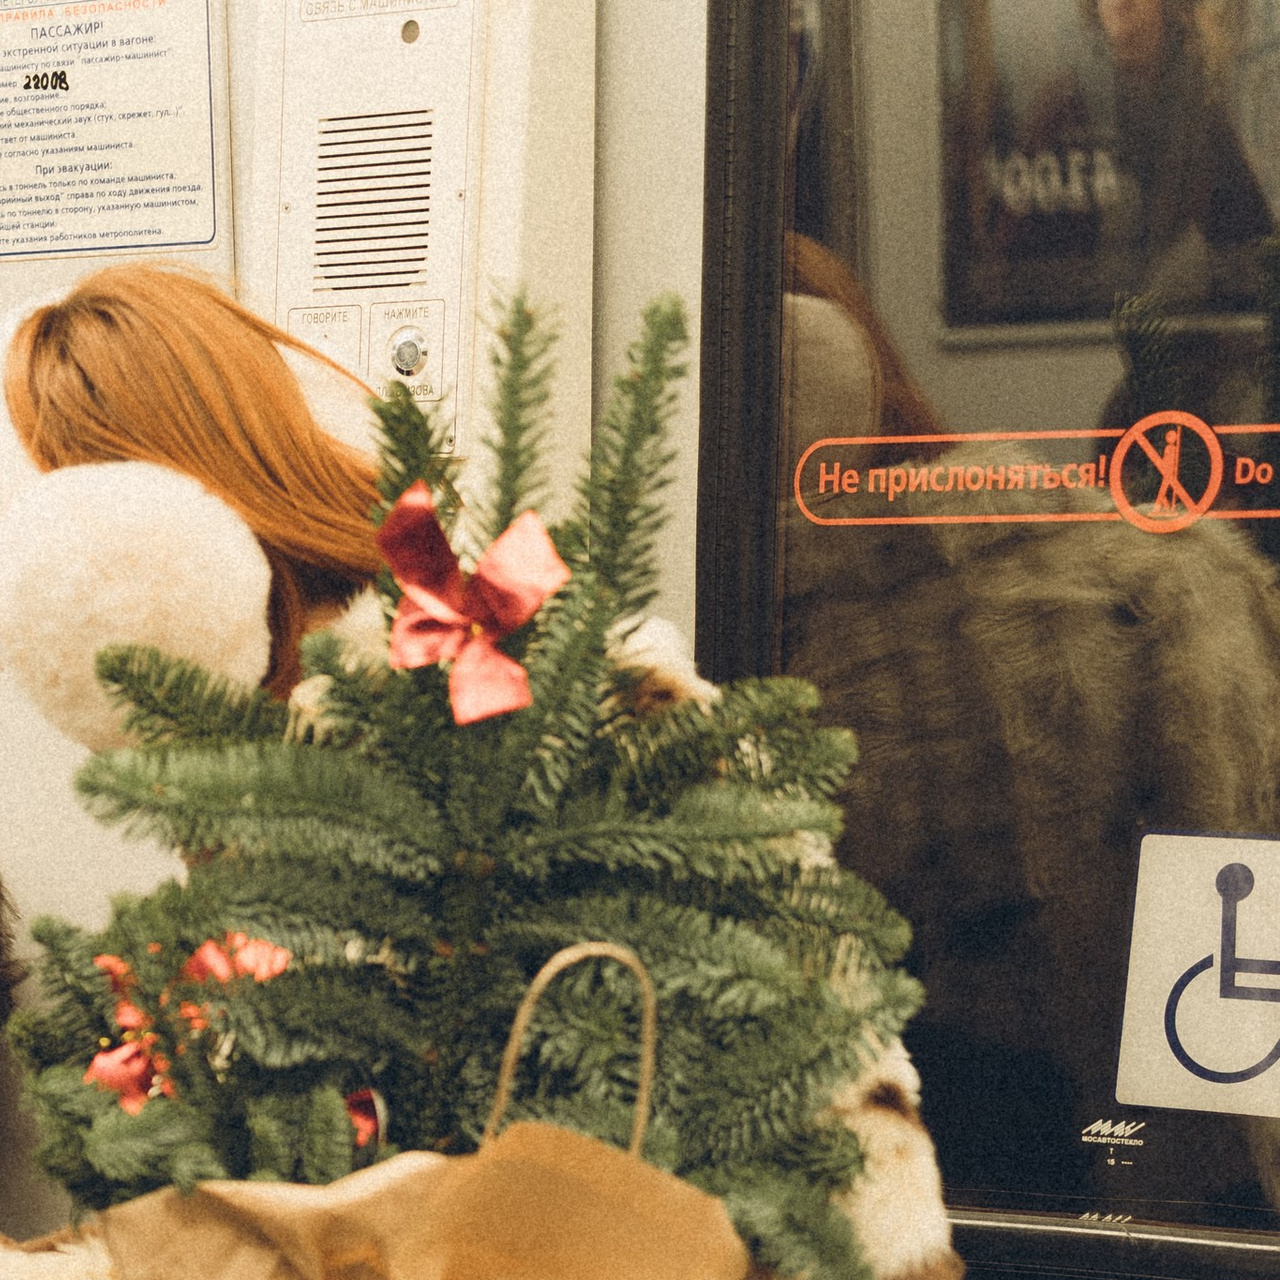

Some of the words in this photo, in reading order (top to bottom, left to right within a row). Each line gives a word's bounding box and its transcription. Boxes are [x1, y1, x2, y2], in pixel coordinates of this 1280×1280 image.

[306, 0, 345, 15] СВЯЗЬ
[30, 22, 104, 39] ПАССАЖИР!
[3, 43, 58, 59] экстренной
[62, 40, 108, 54] ситуации
[120, 35, 156, 46] вагоне:
[7, 105, 68, 116] общественного
[15, 116, 72, 128] механический
[74, 116, 92, 125] звук
[4, 149, 38, 158] согласно
[41, 145, 84, 157] указаниям
[36, 164, 54, 176] При
[57, 162, 112, 174] эвакуации:
[16, 181, 47, 190] тоннель
[49, 180, 76, 188] только
[90, 177, 125, 185] команде
[67, 192, 94, 200] справа
[108, 189, 126, 200] ходу
[129, 187, 170, 196] движения
[7, 210, 16, 218] по
[19, 208, 52, 216] тоннелю
[97, 202, 141, 212] указанную
[11, 235, 47, 245] указания
[50, 232, 97, 242] работников
[302, 311, 348, 324] ГОВОРИТЕ
[384, 307, 429, 320] НАЖМИТЕ
[818, 462, 860, 494] Не
[866, 454, 1108, 502] прислоняться!
[1234, 457, 1274, 486] Do
[1081, 1135, 1144, 1147] МОСАВТОСТЕКЛО
